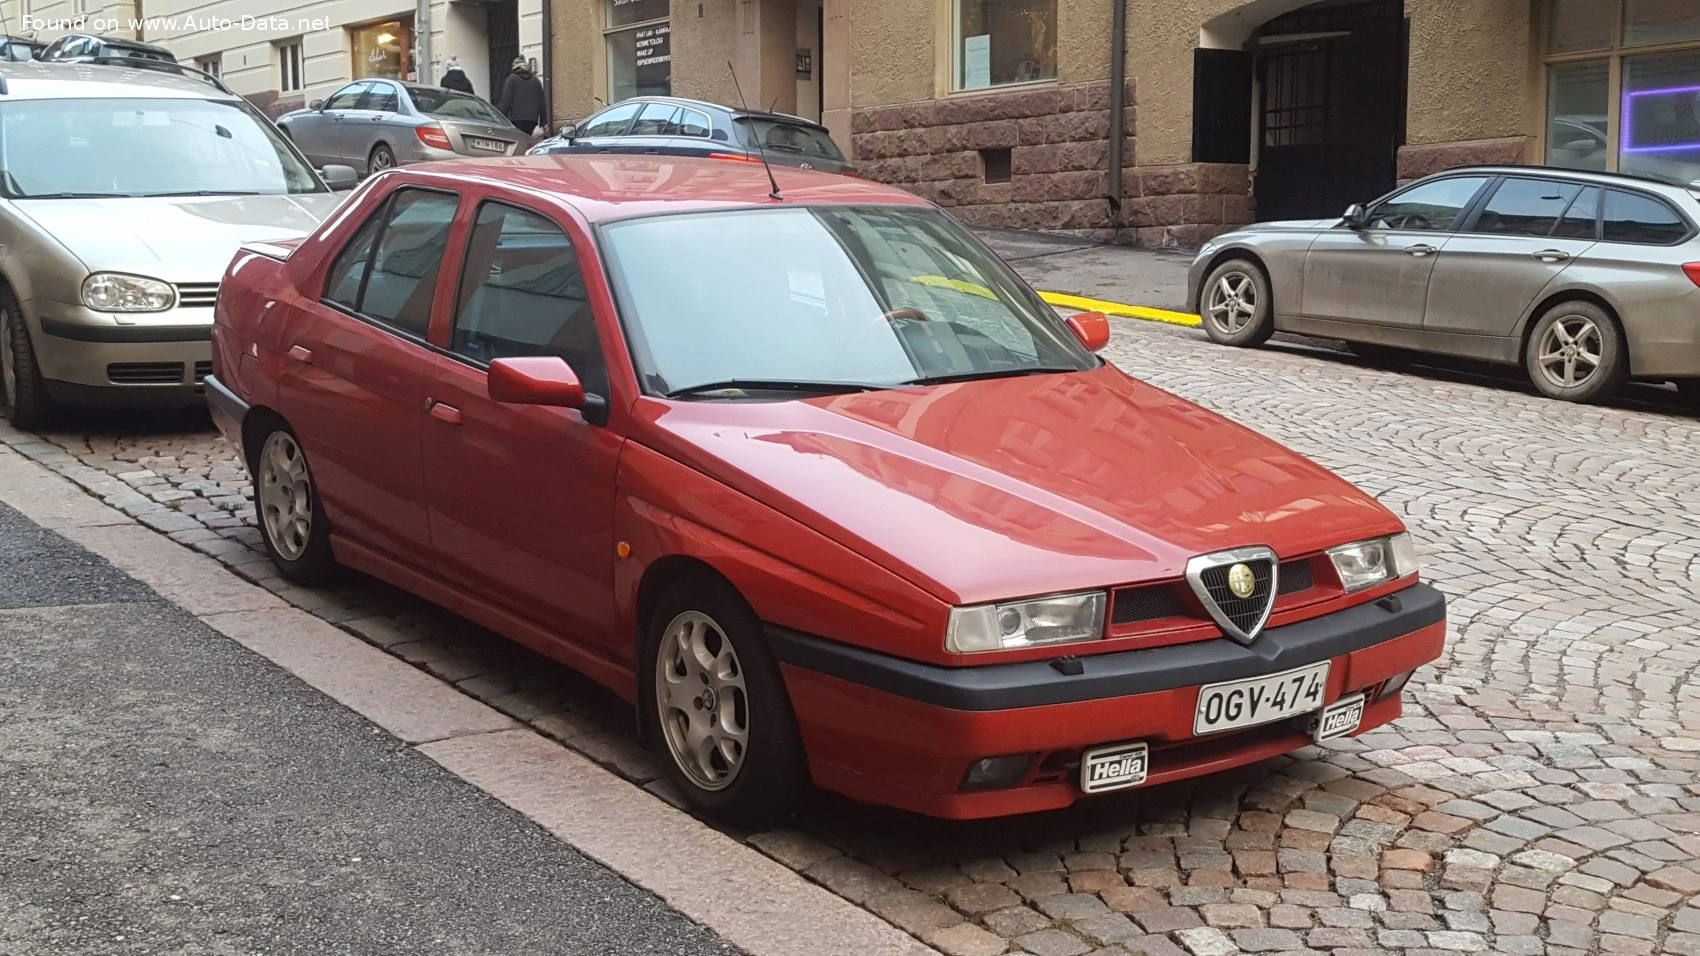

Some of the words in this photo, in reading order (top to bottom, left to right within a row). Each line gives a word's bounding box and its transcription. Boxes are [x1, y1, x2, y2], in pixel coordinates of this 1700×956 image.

[1205, 672, 1319, 724] OGV-474
[1325, 708, 1359, 731] Hella
[1093, 758, 1142, 780] Hella
